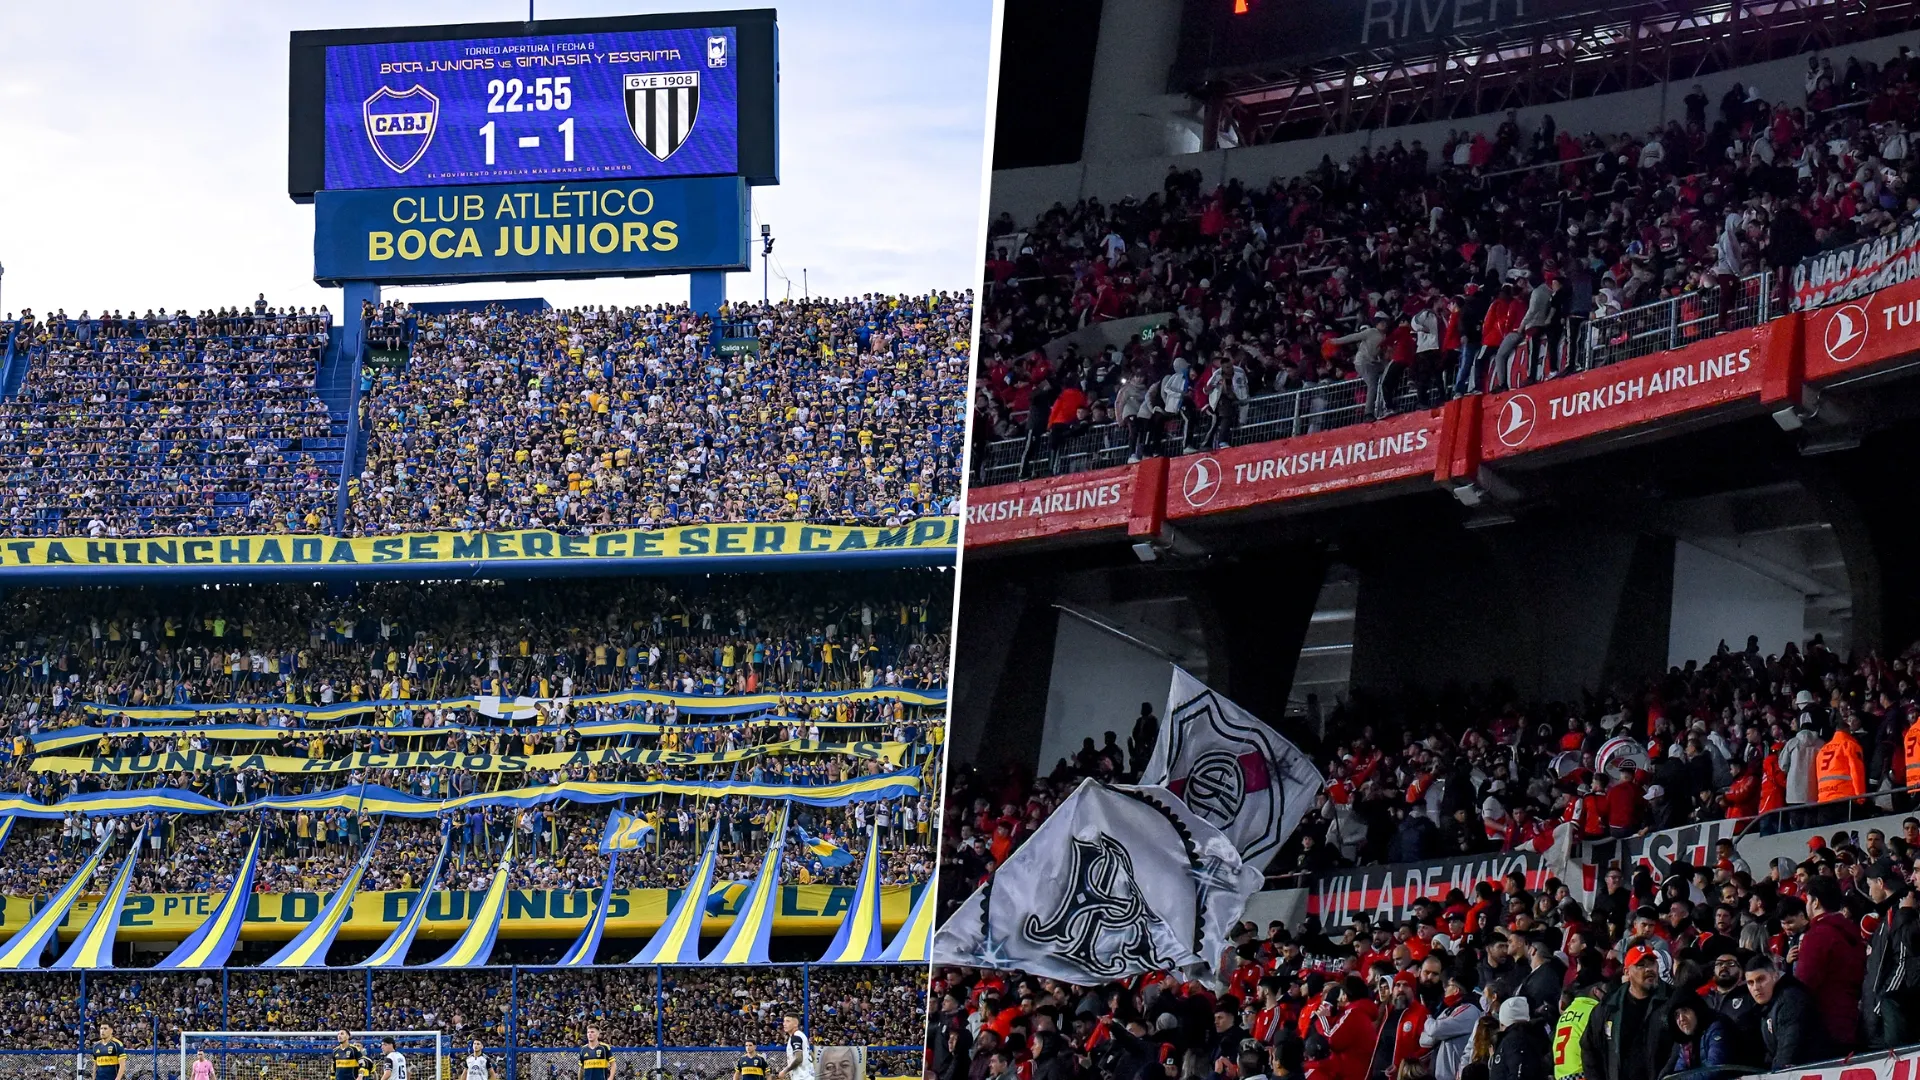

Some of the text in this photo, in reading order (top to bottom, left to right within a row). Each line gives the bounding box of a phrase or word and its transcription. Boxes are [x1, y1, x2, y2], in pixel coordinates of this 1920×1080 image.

[380, 61, 423, 74] BOCA
[426, 58, 495, 72] JUNIORS
[516, 53, 592, 68] GIMNASIA
[594, 53, 605, 64] Y
[608, 49, 681, 64] ESGRIMA
[465, 42, 595, 56] TORNEO APERTURA FECHA 8
[709, 58, 727, 67] LPF
[487, 76, 572, 114] 22:55
[663, 75, 693, 86] 1908
[375, 115, 427, 133] CABJ
[479, 121, 495, 165] 1
[558, 117, 575, 162] 1
[393, 186, 654, 224] CLUB ATLÉTICO
[369, 220, 679, 261] BOCA JUNIORS
[1883, 299, 1920, 330] TU
[1549, 348, 1751, 420] TURKISH AIRLINES
[1234, 428, 1428, 484] TURKISH AIRLINES
[1028, 484, 1120, 517] AIRLINES
[0, 540, 75, 564] TA
[87, 538, 358, 564] HINCHADA
[372, 536, 439, 562] SE
[452, 532, 663, 559] MERECE
[678, 526, 786, 555] SER
[91, 750, 266, 772] NUNCA
[301, 751, 531, 772] HICIMOS
[1821, 751, 1835, 770] 3
[1319, 871, 1394, 927] VILLA
[1401, 866, 1443, 922] DE
[1555, 1025, 1573, 1065] 3
